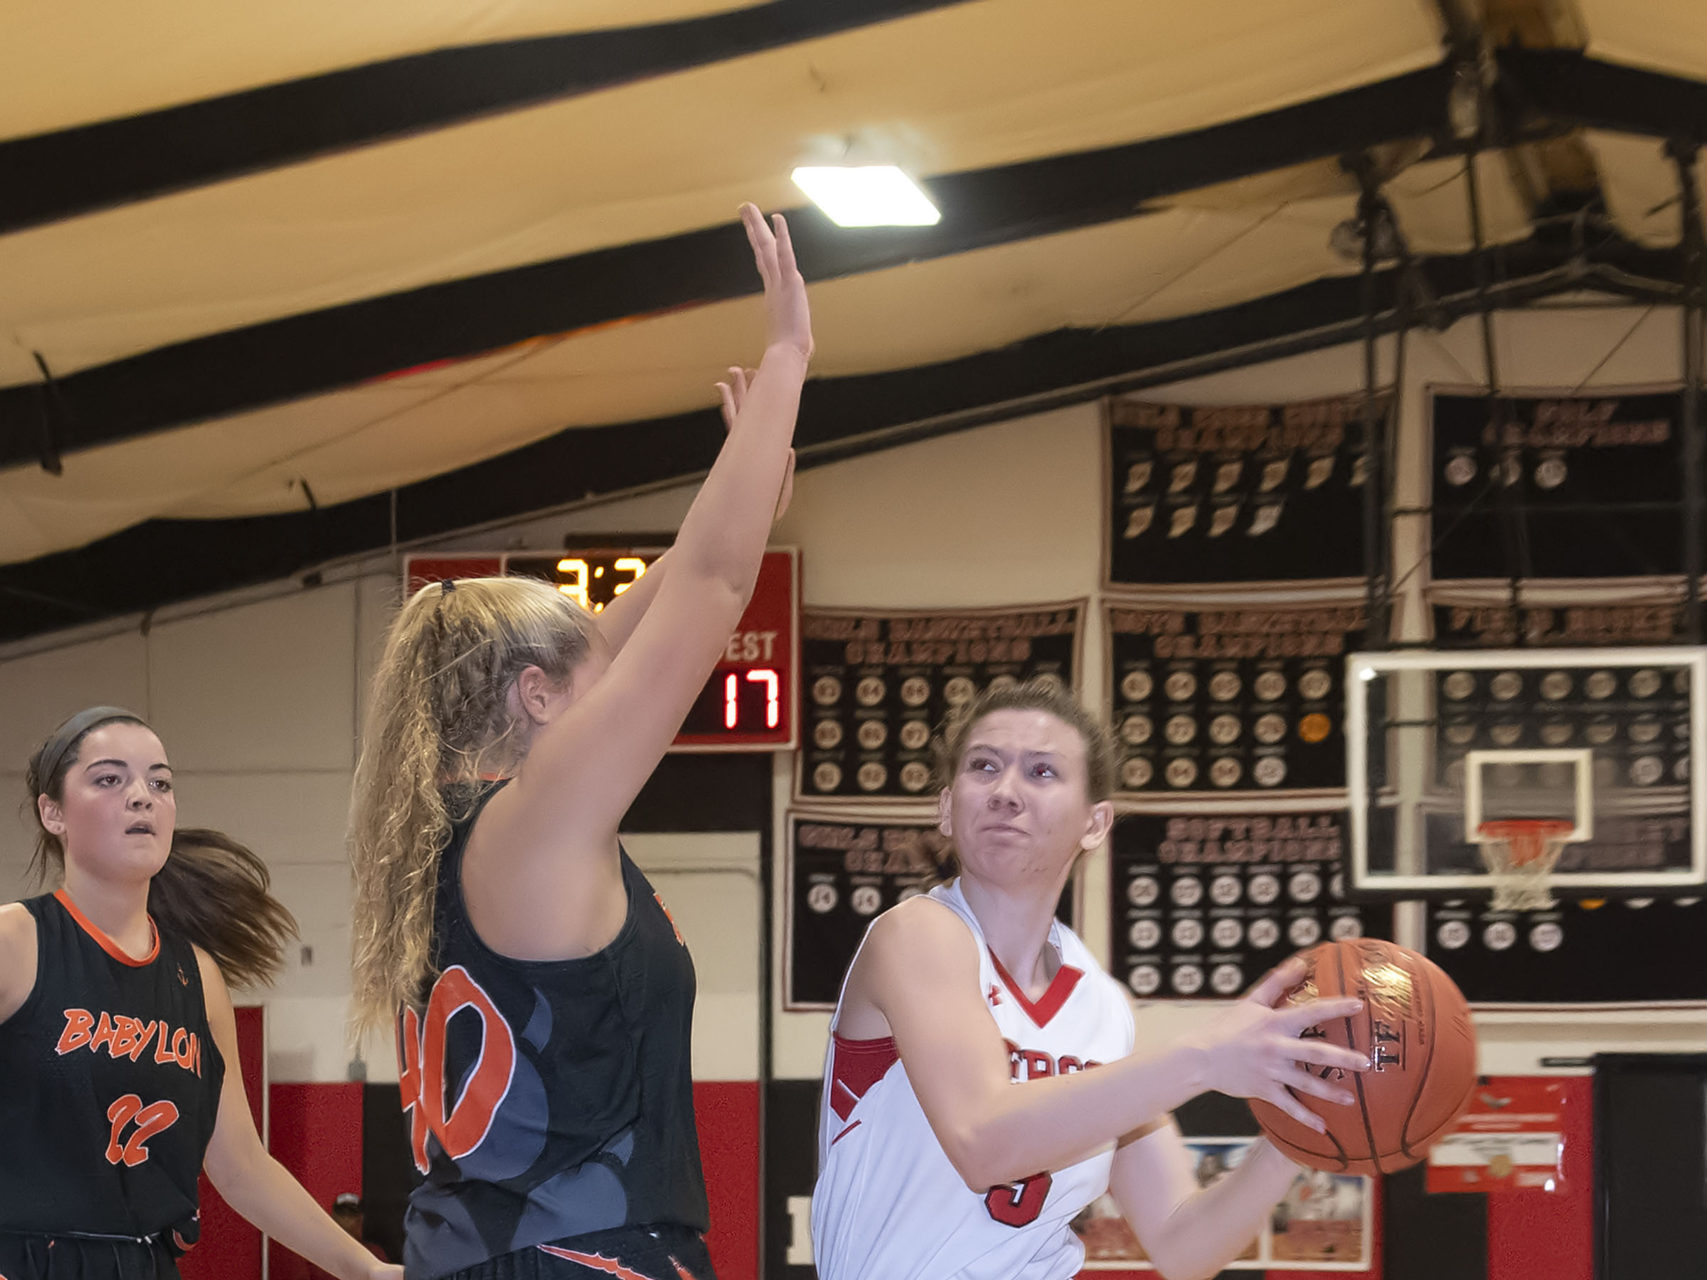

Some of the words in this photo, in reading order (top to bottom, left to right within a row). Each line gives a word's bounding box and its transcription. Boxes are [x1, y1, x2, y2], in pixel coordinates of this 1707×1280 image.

[724, 630, 778, 662] EST
[724, 668, 780, 729] 17
[105, 1093, 180, 1168] 22
